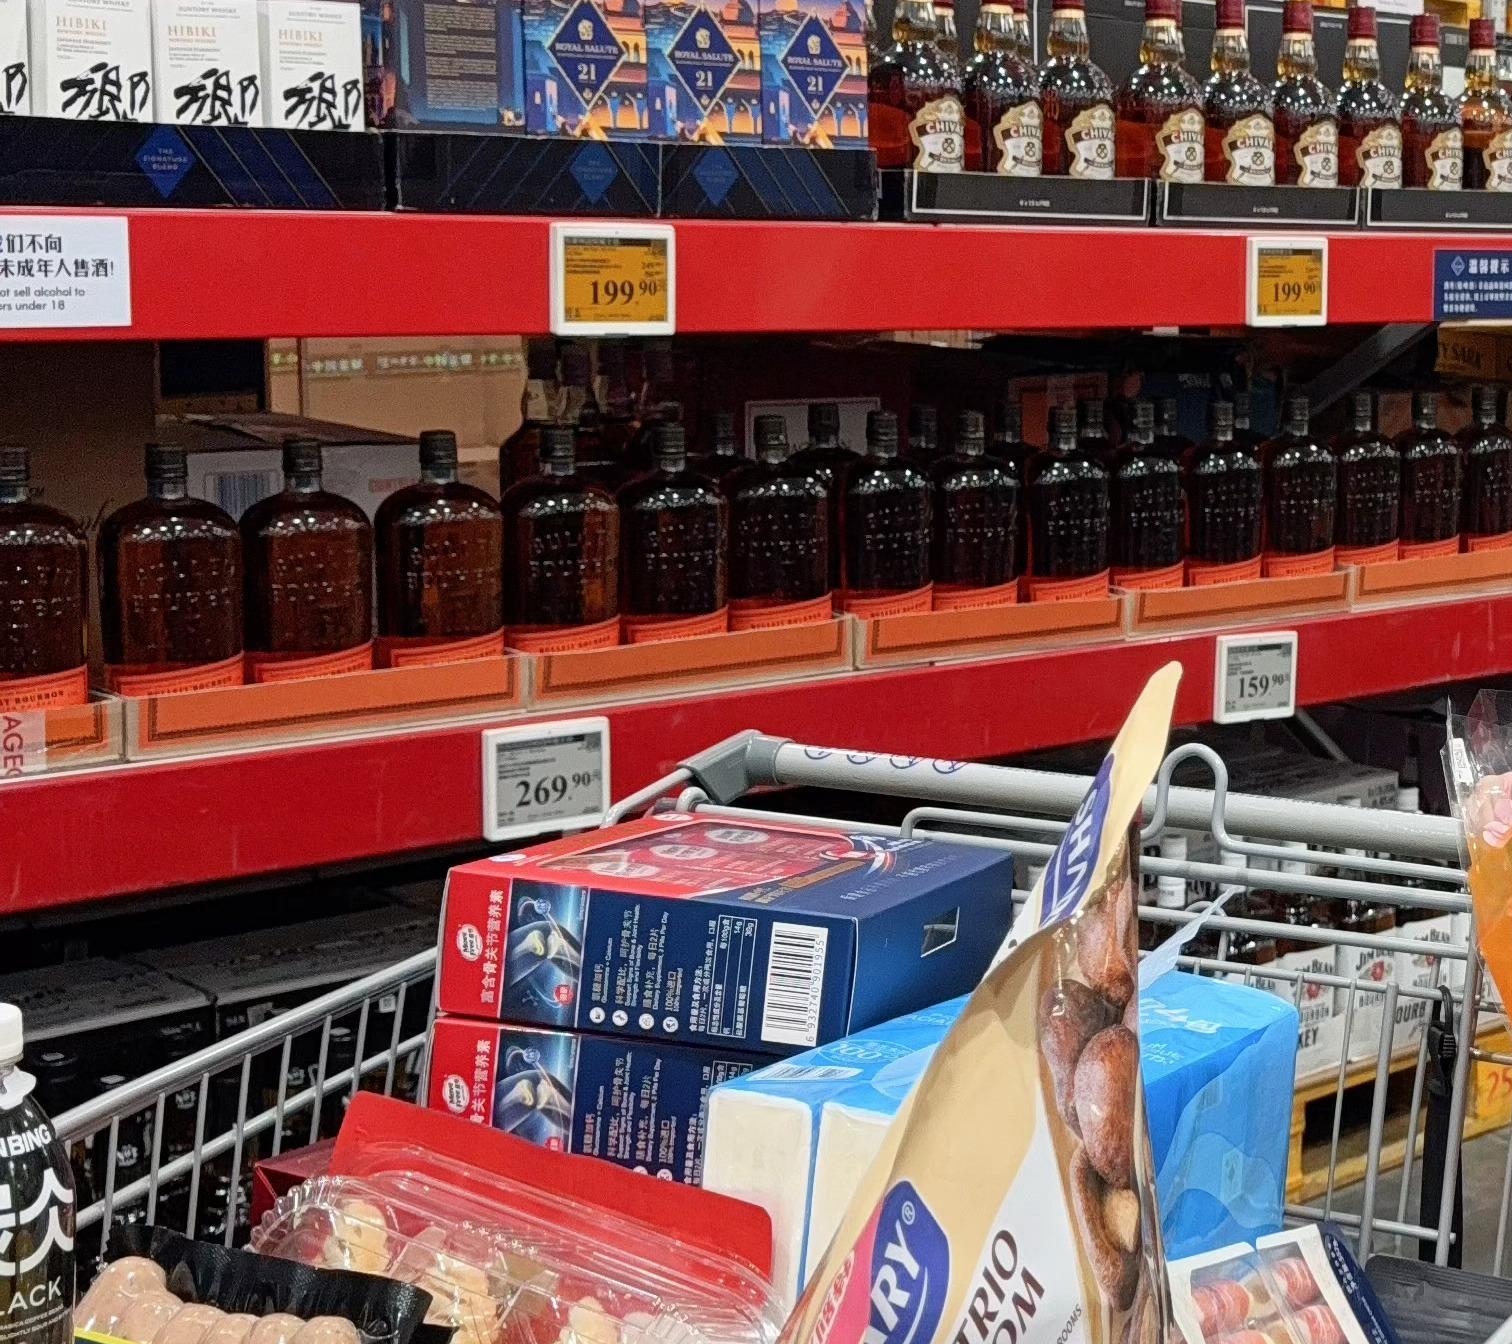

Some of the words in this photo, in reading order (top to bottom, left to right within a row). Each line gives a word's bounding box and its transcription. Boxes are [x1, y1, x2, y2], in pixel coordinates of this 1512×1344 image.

[56, 16, 107, 31] HIBIKI
[168, 25, 217, 38] HIBIKI
[278, 29, 323, 42] HIBIKI
[555, 42, 584, 52] ROYAL
[585, 44, 619, 55] SALUTE
[674, 50, 700, 59] ROYAL
[702, 52, 734, 63] SALUTE
[787, 56, 812, 66] ROYAL
[813, 58, 843, 68] SALUTE
[577, 63, 596, 81] 21
[695, 70, 714, 87] 21
[806, 76, 824, 92] 21
[0, 233, 62, 253] 们不向
[14, 286, 30, 297] sell
[34, 286, 72, 297] alcohol
[75, 288, 85, 297] to
[15, 300, 47, 310] under
[52, 300, 65, 310] 18
[480, 889, 504, 1003] 富含骨关节营养素
[812, 939, 825, 982] 901955
[807, 986, 820, 1029] 932740
[0, 1275, 62, 1316] ACK
